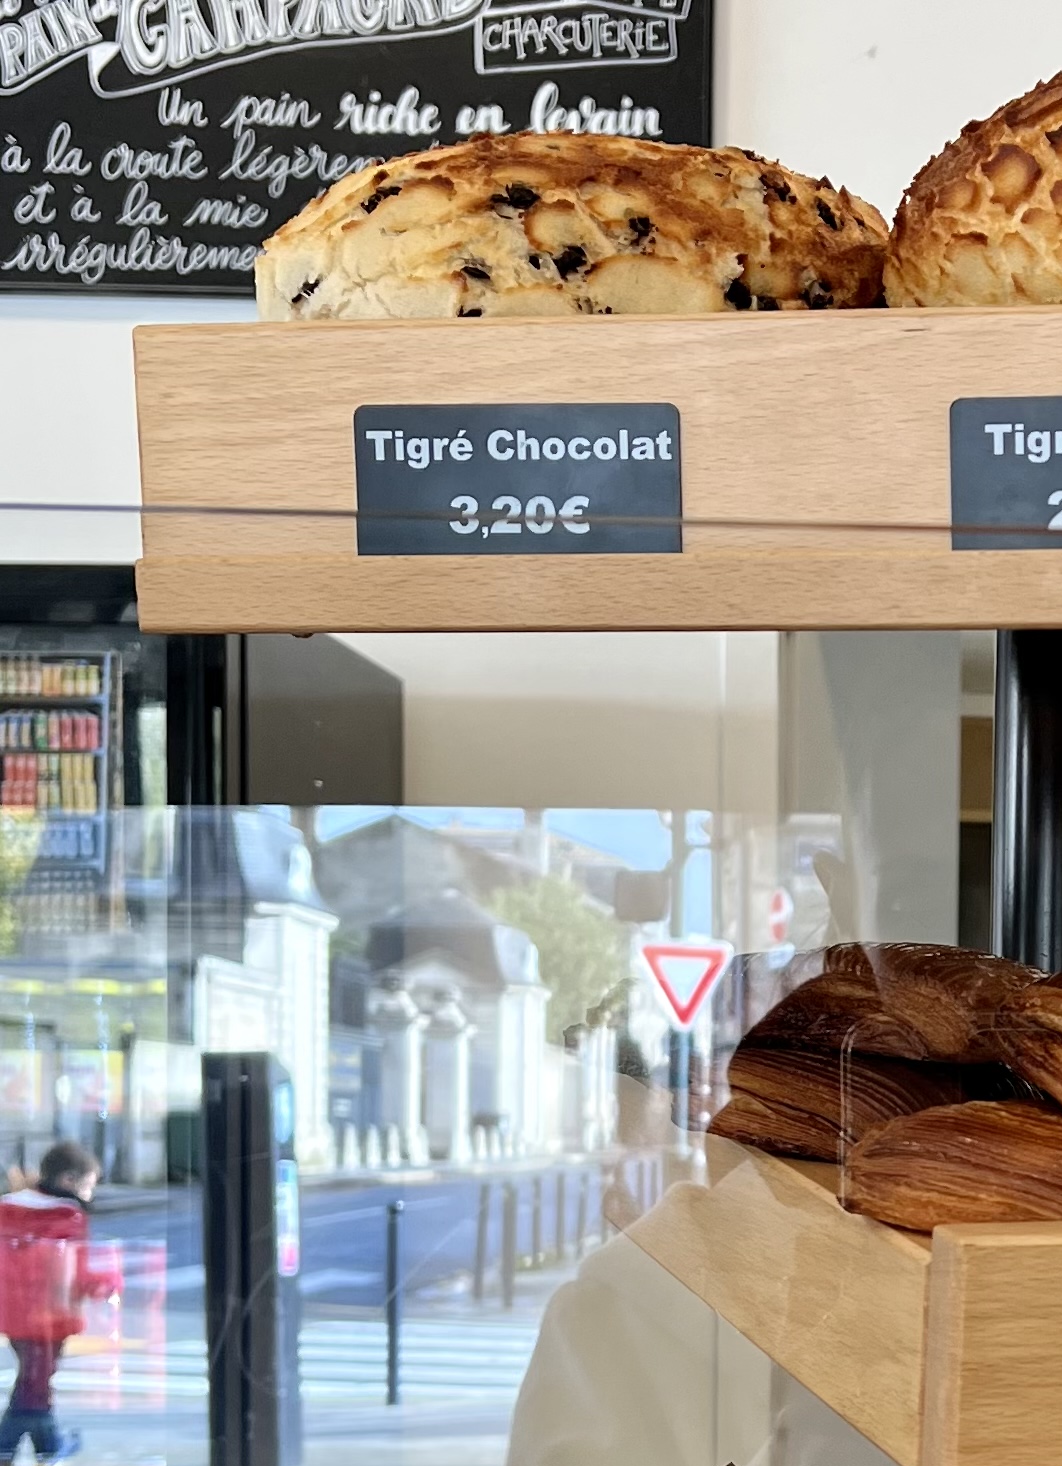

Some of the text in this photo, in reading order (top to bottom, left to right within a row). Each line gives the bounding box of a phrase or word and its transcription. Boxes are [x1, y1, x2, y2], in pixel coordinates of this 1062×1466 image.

[0, 0, 102, 86] PAIN
[158, 81, 663, 139] Un pain riche en levain
[1, 134, 31, 174] à
[43, 122, 92, 176] la
[13, 180, 269, 228] et à la mie
[366, 430, 673, 469] Tigré Chocolat
[449, 494, 591, 539] 3,20€
